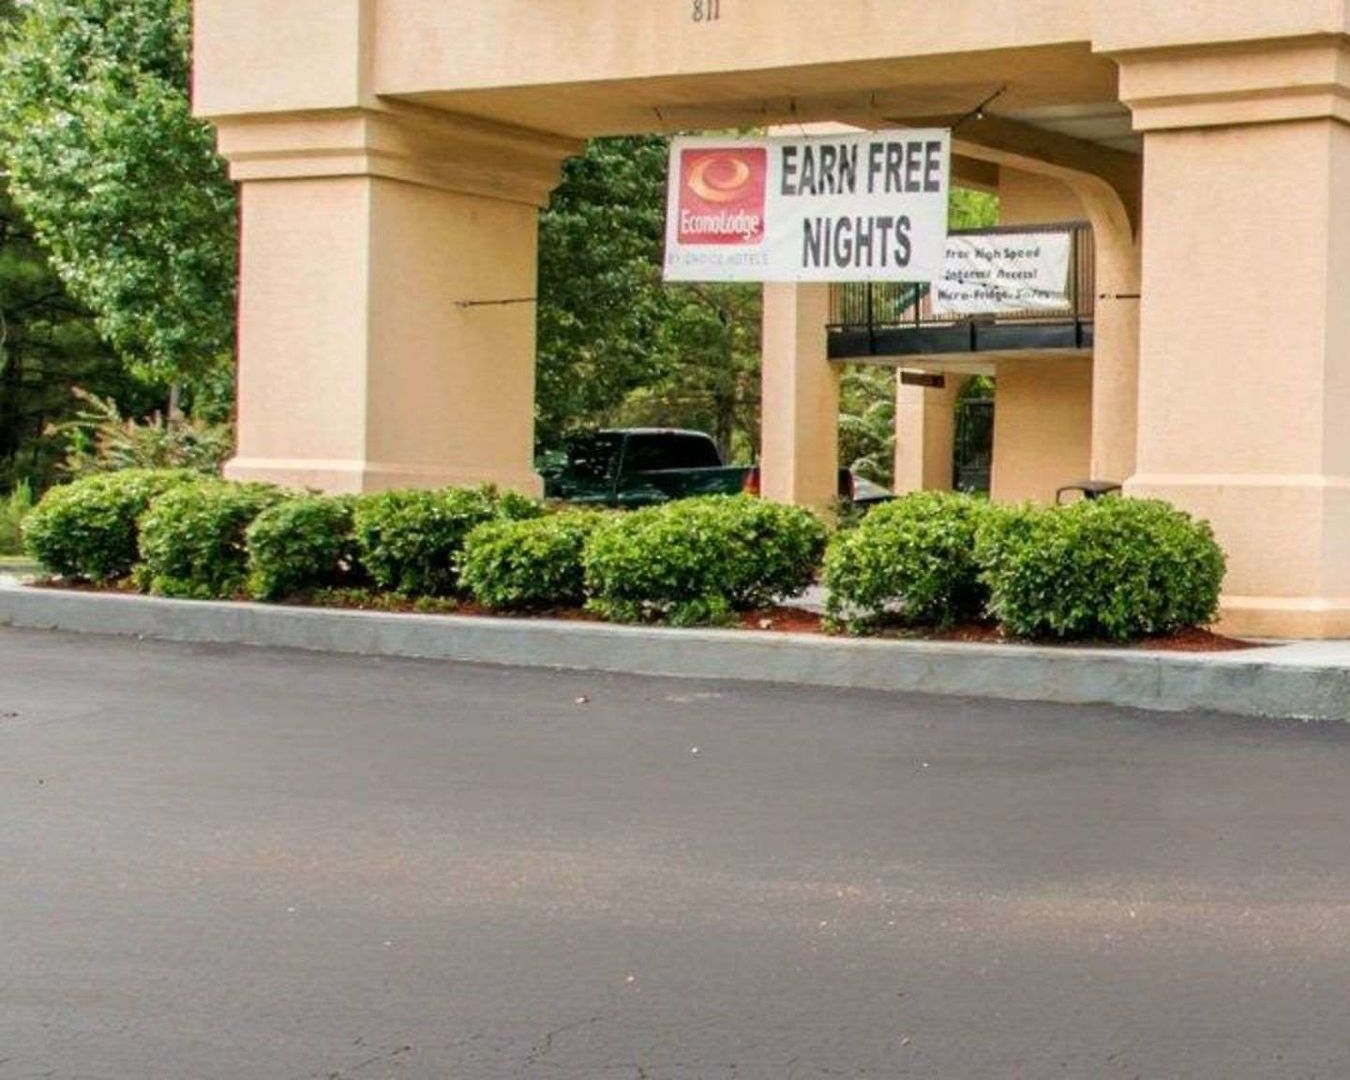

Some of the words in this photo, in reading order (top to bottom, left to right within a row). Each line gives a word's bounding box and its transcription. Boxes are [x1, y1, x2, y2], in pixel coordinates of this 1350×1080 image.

[781, 144, 857, 195] EARN
[868, 141, 941, 193] FREE
[681, 209, 761, 240] EconoLodge
[803, 216, 911, 268] NIGHTS
